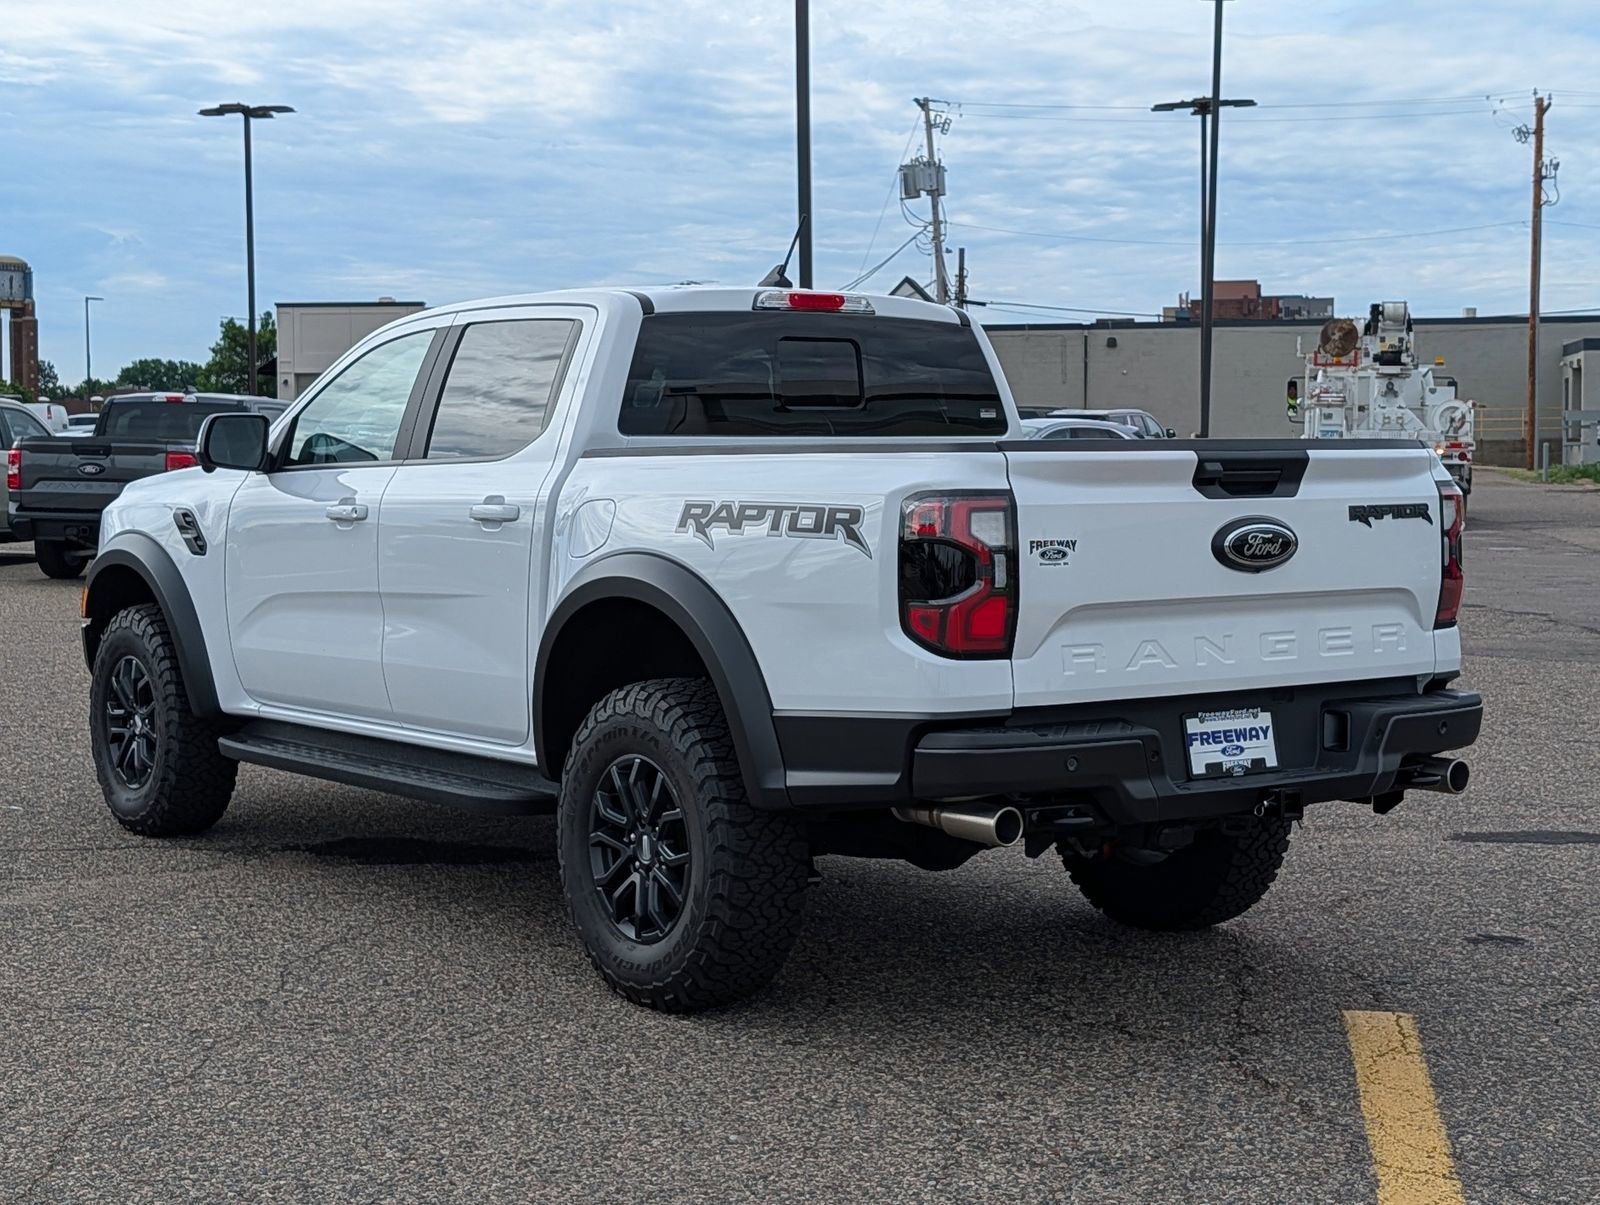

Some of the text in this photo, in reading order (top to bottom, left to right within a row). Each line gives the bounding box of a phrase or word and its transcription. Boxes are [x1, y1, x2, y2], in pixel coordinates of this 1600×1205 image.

[1348, 503, 1433, 528] RAPTOR
[675, 500, 872, 560] RAPTOR
[1029, 539, 1077, 555] FREEWAY
[1245, 533, 1282, 556] Ford
[1060, 622, 1406, 676] RANGER
[1187, 725, 1271, 748] FREEWAY
[1224, 745, 1241, 756] Ford
